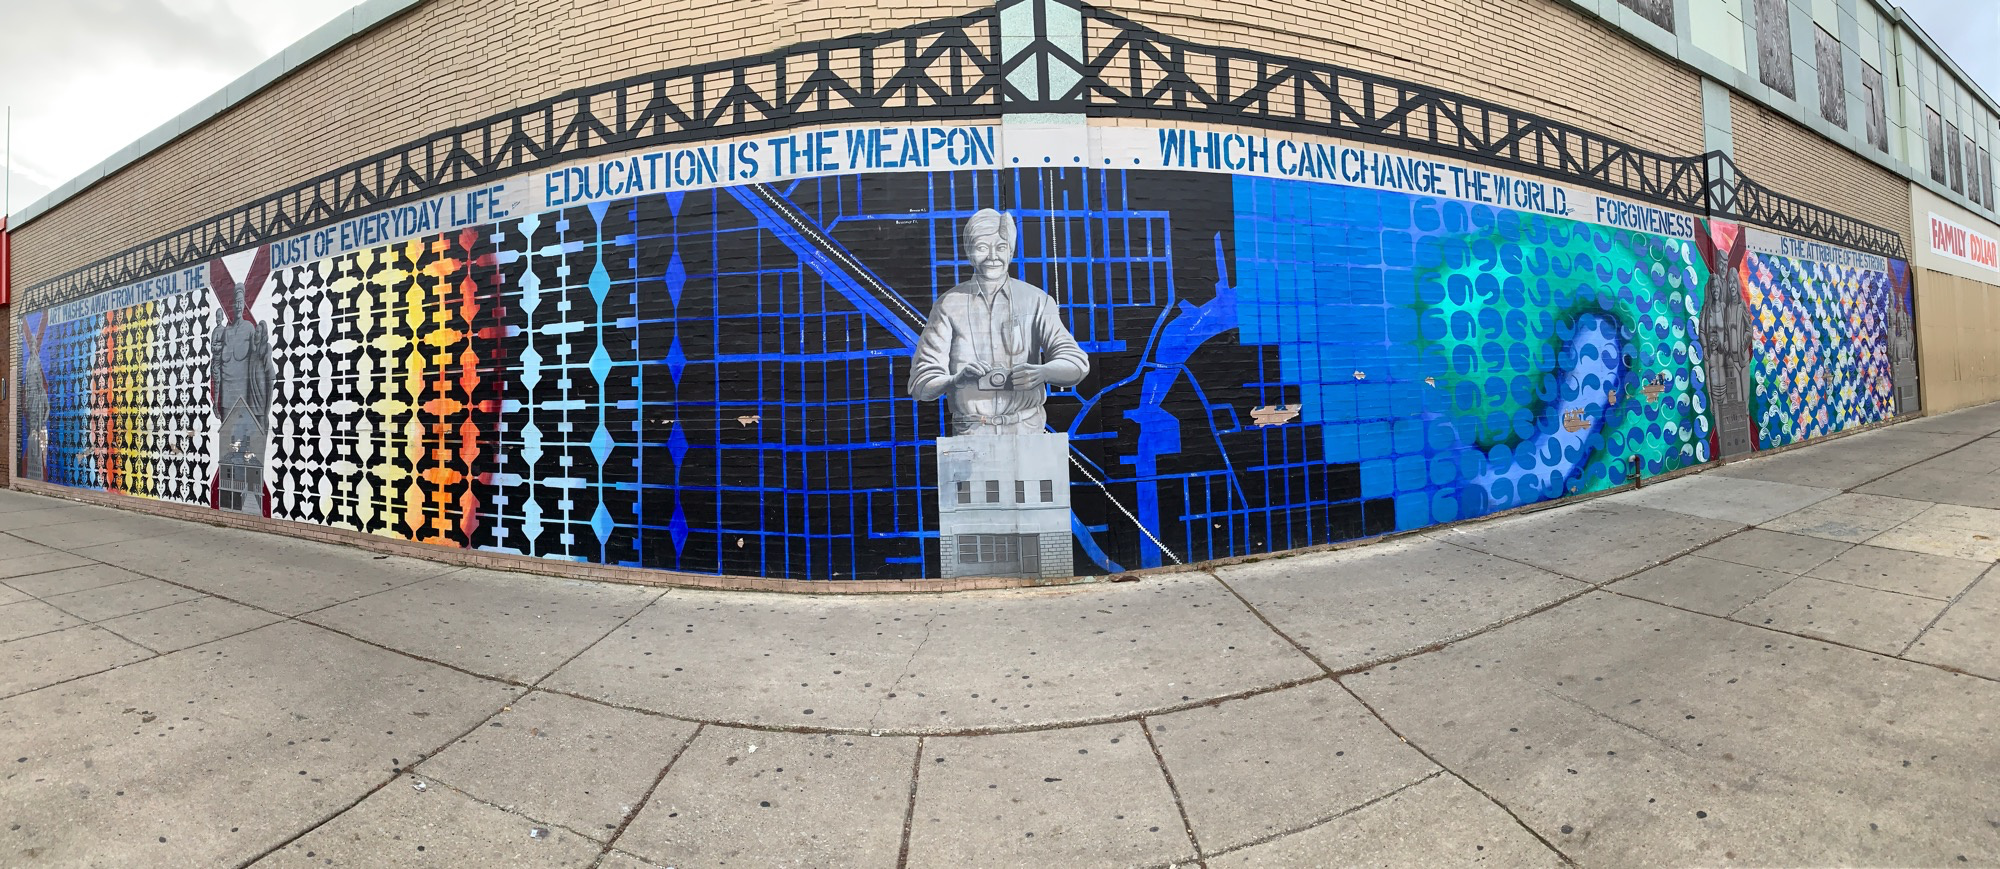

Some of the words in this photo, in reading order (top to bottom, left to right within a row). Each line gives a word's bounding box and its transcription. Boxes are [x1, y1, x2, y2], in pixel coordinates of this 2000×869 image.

[546, 146, 719, 207] EDUCATION
[728, 141, 759, 181] IS
[768, 130, 839, 177] THE
[846, 127, 994, 169] WEAPON
[1159, 128, 1269, 173] WHICH
[1276, 139, 1336, 181] CAN
[1341, 149, 1446, 195] CHANGE
[1448, 165, 1492, 203] THE
[1494, 174, 1569, 217] WORLD.
[271, 234, 309, 269] DUST
[314, 226, 336, 257] OF
[340, 197, 443, 250] EVERYDAY
[450, 184, 510, 227] LIFE.
[1595, 196, 1693, 239] FORGIVENESS
[1931, 217, 1967, 258] FAMILY
[1780, 236, 1789, 255] IS
[1789, 238, 1806, 258] THE
[1806, 242, 1843, 266] ATTRIBUTE
[1843, 250, 1851, 268] OF
[1851, 252, 1864, 270] THE
[1863, 254, 1886, 272] STRONG
[50, 307, 61, 324] ART
[63, 300, 89, 319] WASHES
[90, 292, 110, 314] AWAY
[111, 287, 134, 308] FROM
[136, 279, 154, 304] THE
[155, 274, 182, 297] SOUL
[183, 265, 205, 291] THE
